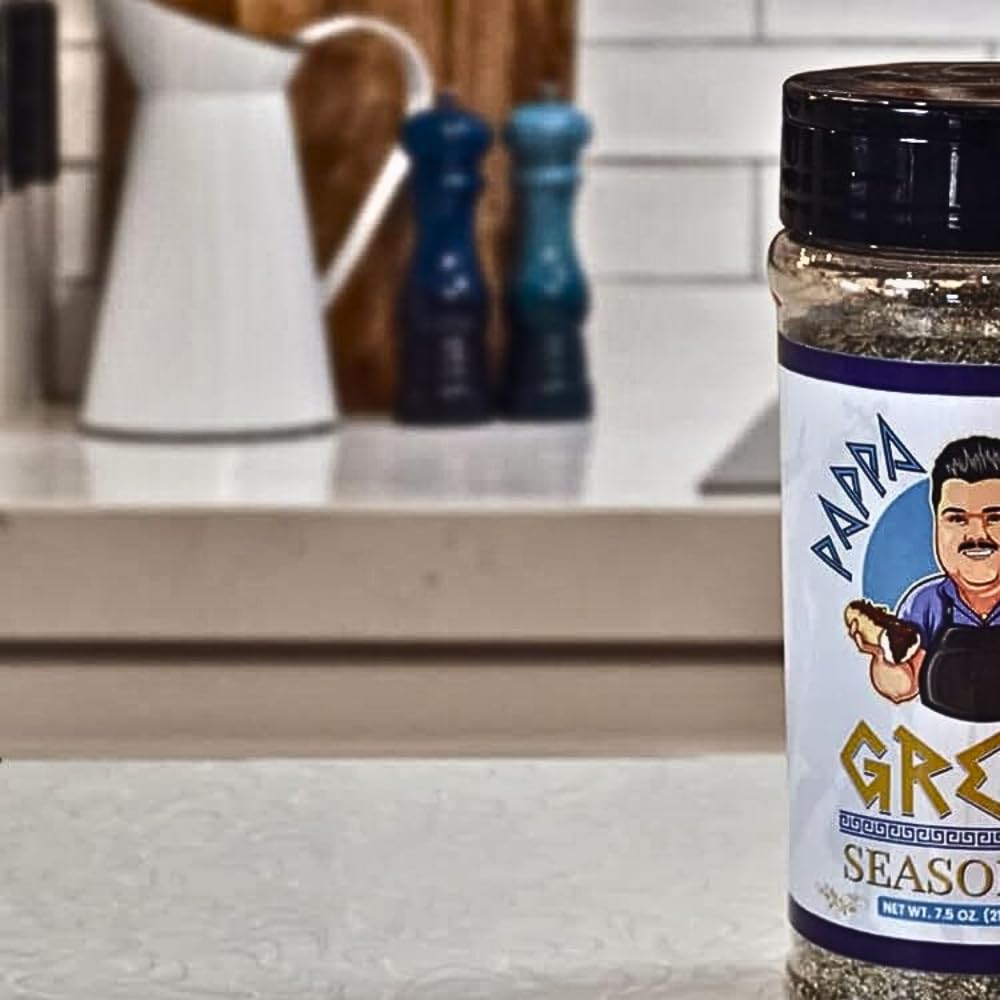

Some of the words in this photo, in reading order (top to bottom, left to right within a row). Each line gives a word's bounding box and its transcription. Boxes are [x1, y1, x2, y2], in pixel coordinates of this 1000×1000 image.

[811, 412, 927, 582] PAPPA
[883, 902, 905, 913] NET
[907, 905, 932, 918] WT.
[934, 907, 954, 920] 7.5
